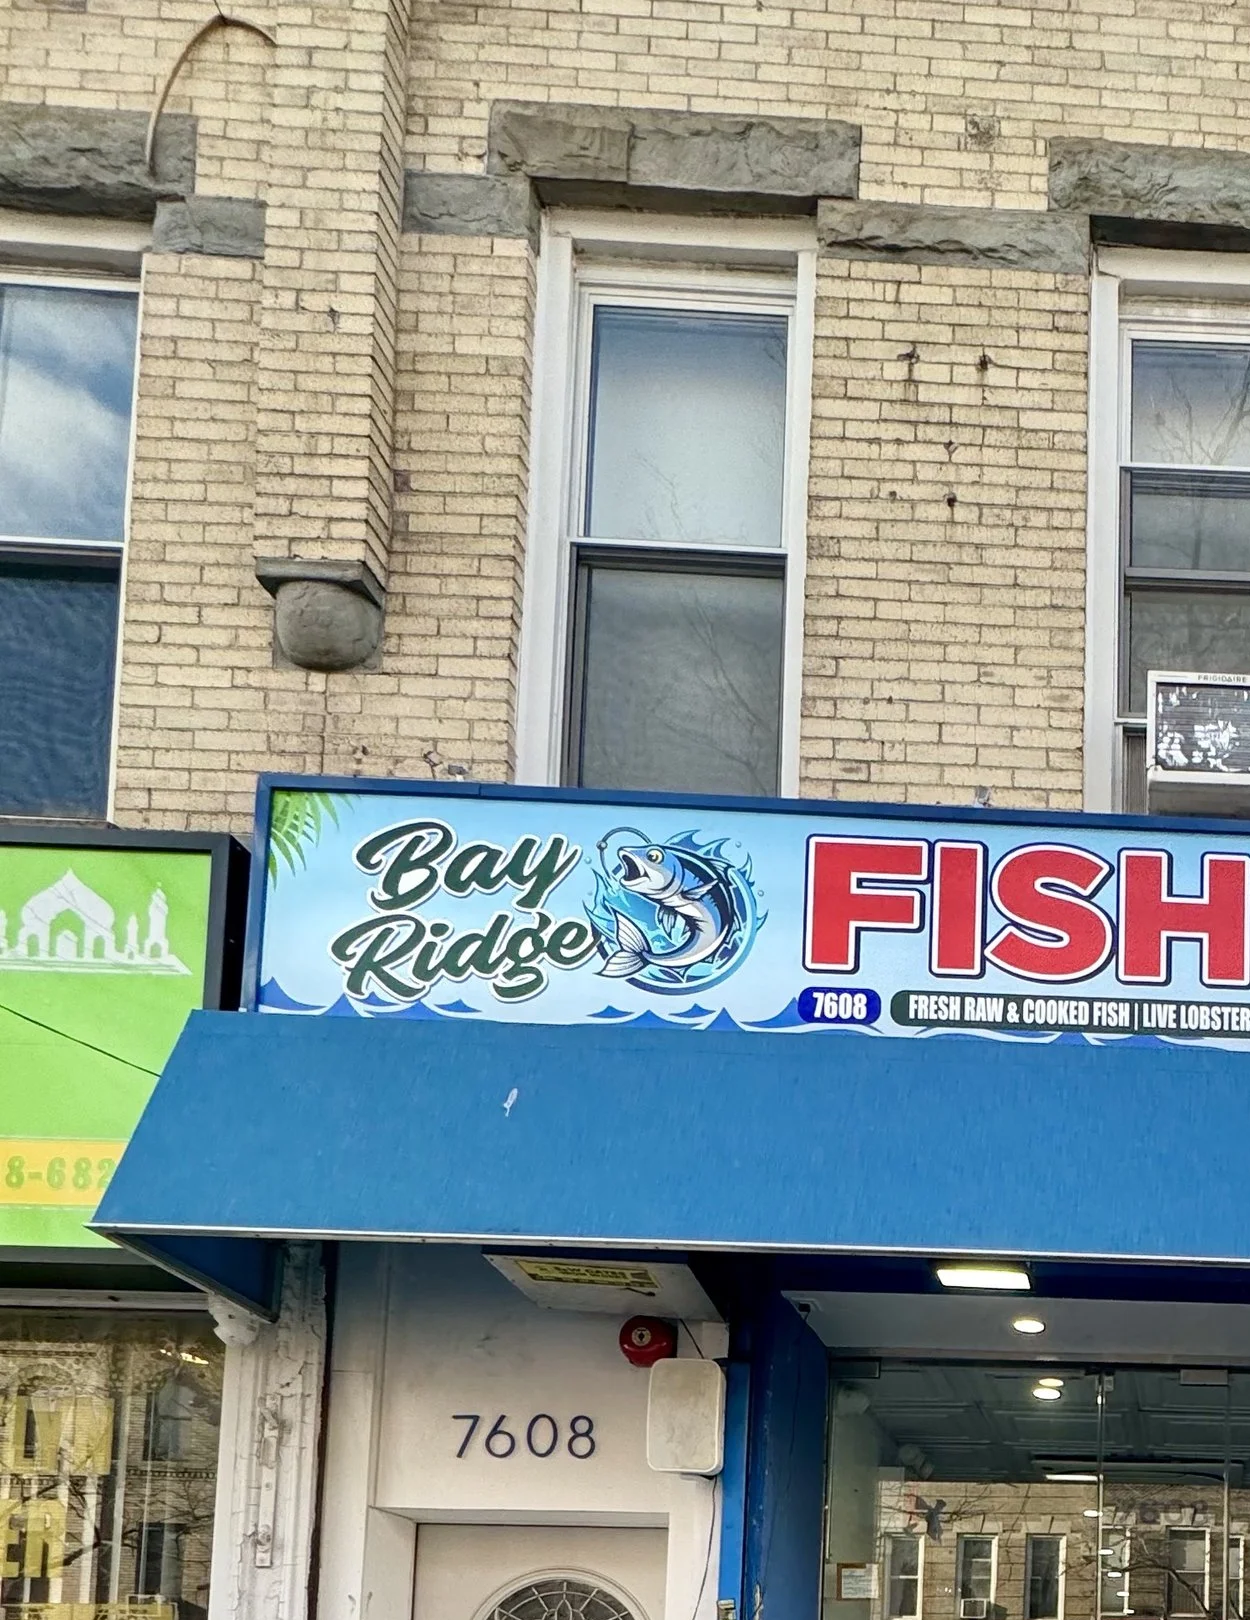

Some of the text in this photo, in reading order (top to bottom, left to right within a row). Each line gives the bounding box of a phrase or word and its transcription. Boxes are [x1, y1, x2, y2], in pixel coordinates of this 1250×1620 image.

[1198, 675, 1247, 683] FRIGIDAIRE
[355, 821, 578, 909] Bay
[330, 912, 600, 1000] Ridge
[812, 992, 867, 1019] 7608
[908, 994, 961, 1020] FRESH
[963, 996, 1005, 1023] RAW
[1006, 999, 1020, 1024] &
[1022, 999, 1089, 1026] COOKED
[1093, 1001, 1131, 1027] FISH
[1143, 1003, 1177, 1029] LIVE
[1180, 1004, 1250, 1032] LOBSTER
[452, 1414, 596, 1459] 7608
